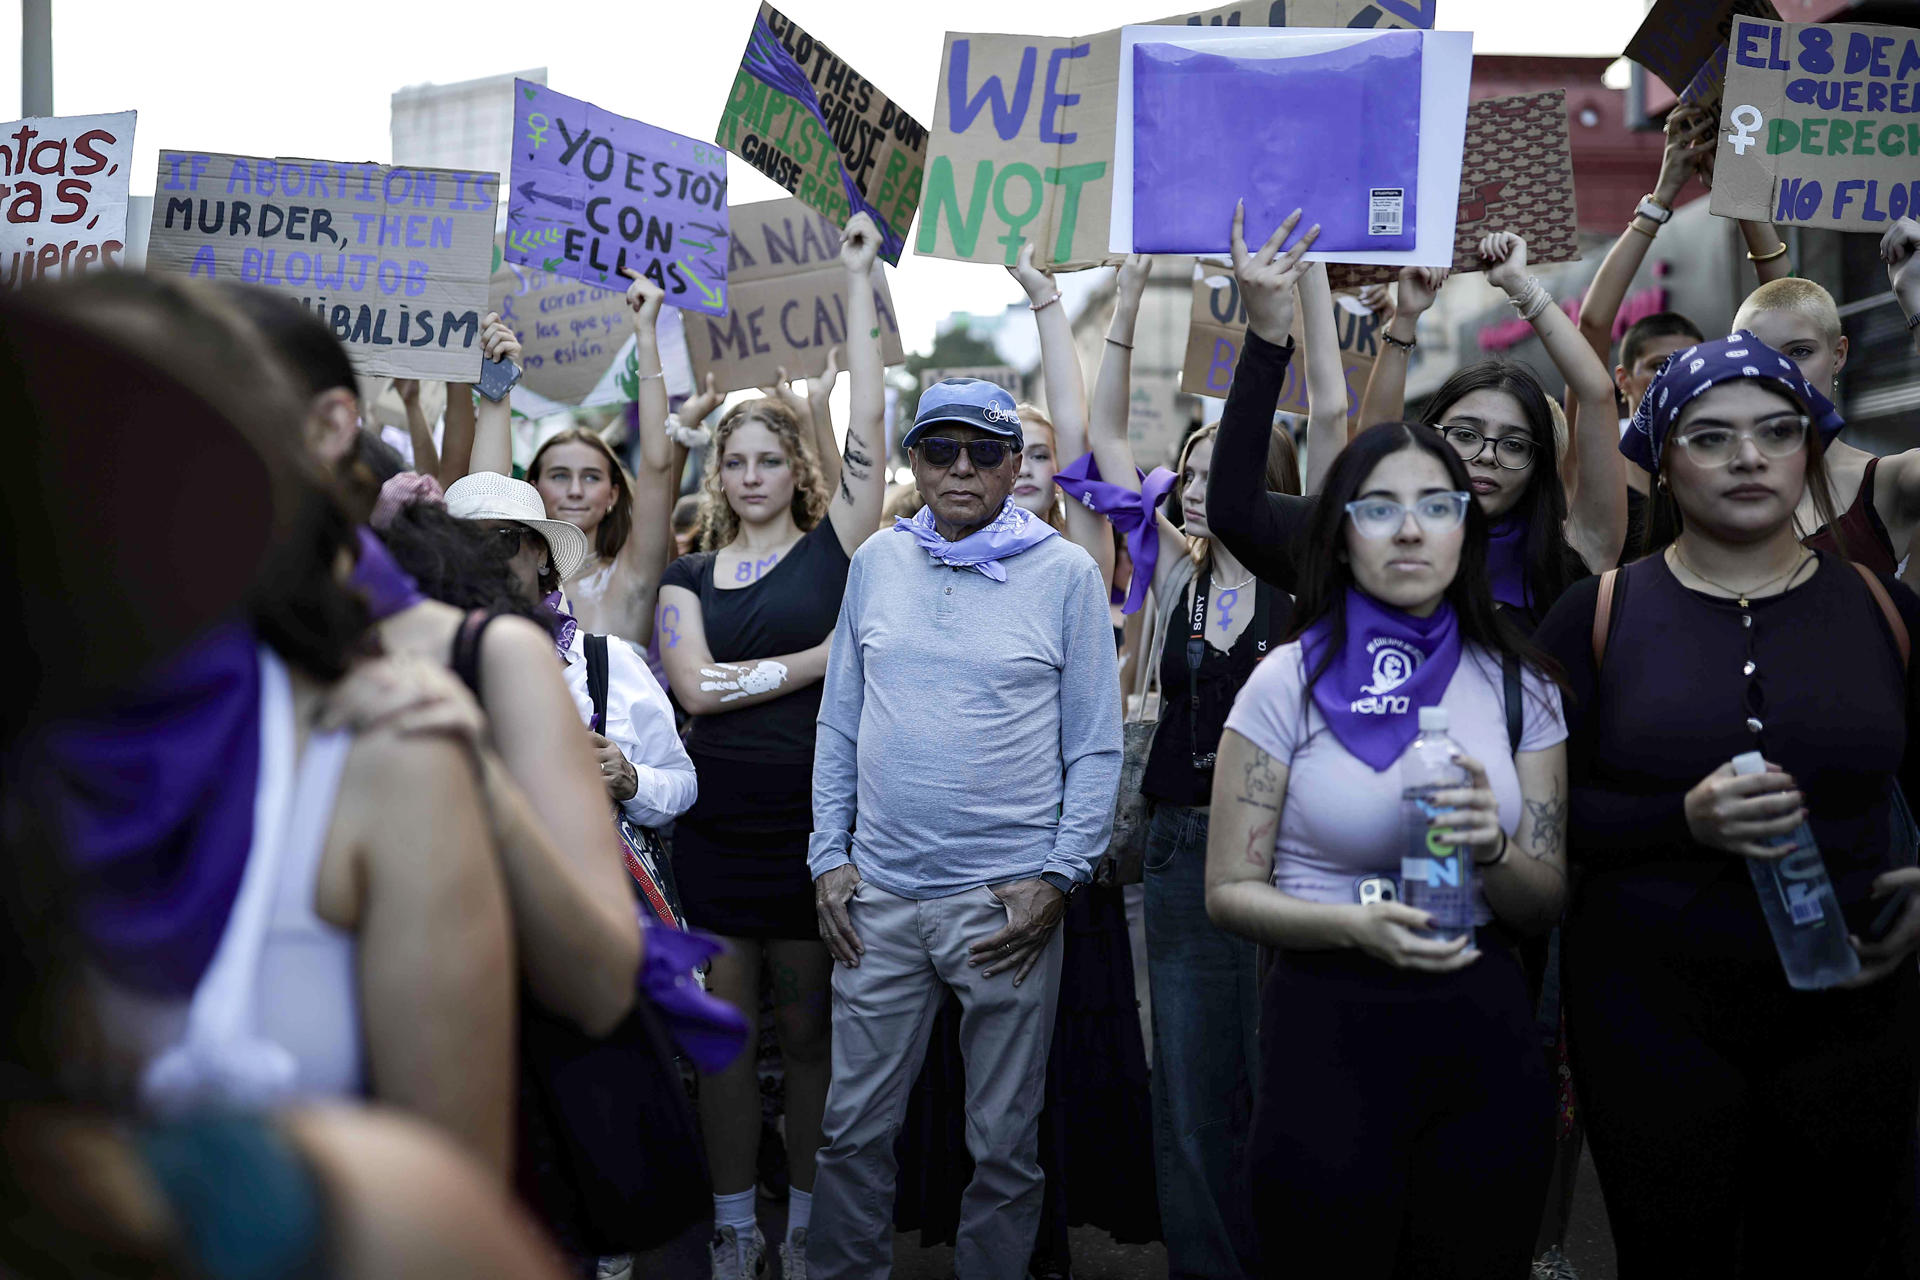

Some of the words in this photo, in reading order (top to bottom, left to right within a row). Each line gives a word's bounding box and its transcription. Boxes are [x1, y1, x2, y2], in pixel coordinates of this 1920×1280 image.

[769, 8, 873, 113] CLOTHES
[1736, 22, 1790, 71] EL
[1798, 27, 1834, 74] 8
[1844, 32, 1895, 77] DE
[948, 39, 1090, 144] WE
[556, 118, 614, 182] YO
[625, 152, 727, 211] ESTOY
[741, 134, 802, 196] CAUSE
[819, 93, 887, 198] CAUSE
[164, 154, 211, 191] IF
[226, 159, 437, 207] ABORTION
[449, 172, 494, 211] IS
[800, 171, 850, 228] RAPE
[917, 155, 1106, 265] NOT
[1776, 177, 1822, 221] NO
[165, 197, 347, 250] MURDER,
[353, 213, 454, 248] THEN
[586, 197, 672, 253] CON
[189, 245, 216, 280] A
[240, 248, 429, 297] BLOWJOB
[565, 228, 687, 294] ELLAS
[536, 321, 560, 340] las
[570, 316, 597, 337] que
[601, 313, 622, 335] ya
[706, 307, 770, 361] ME
[735, 552, 778, 582] 8M
[1193, 594, 1205, 631] SONY
